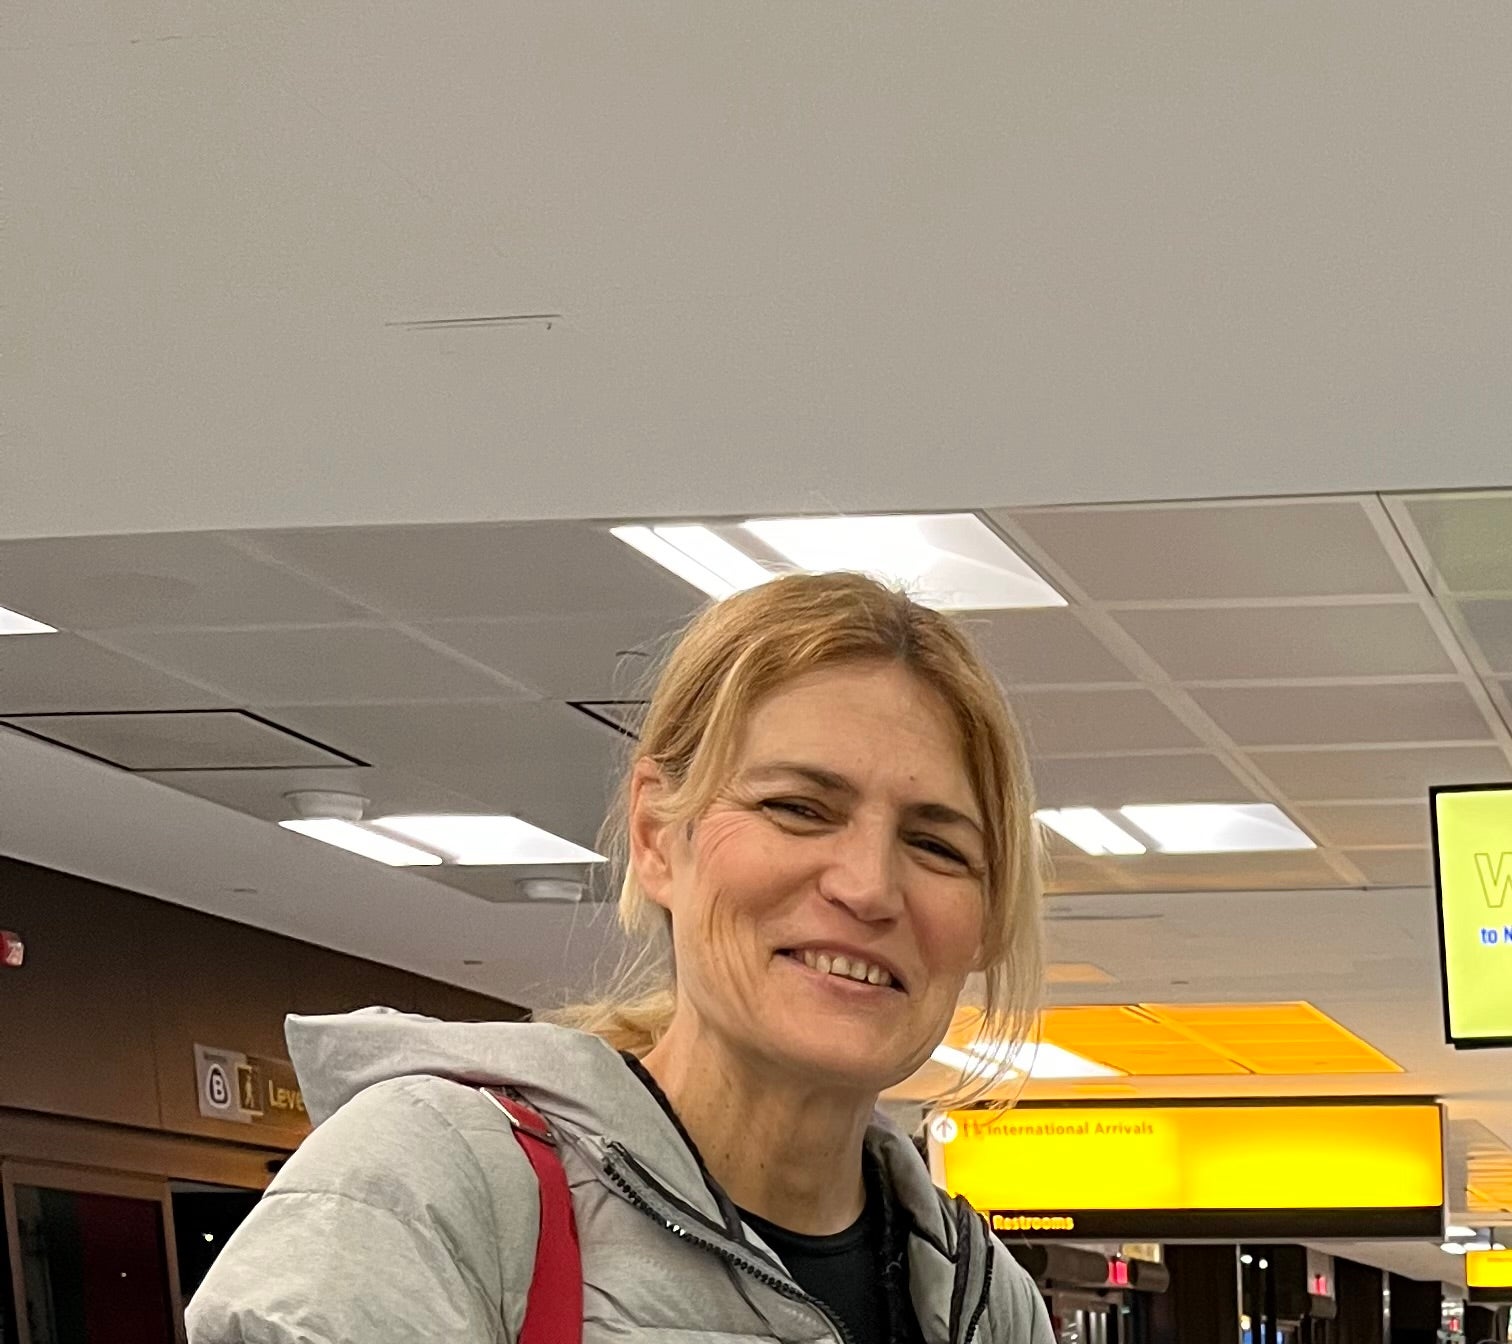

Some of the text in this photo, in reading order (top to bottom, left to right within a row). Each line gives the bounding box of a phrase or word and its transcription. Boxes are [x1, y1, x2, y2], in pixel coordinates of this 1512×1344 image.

[1481, 927, 1498, 944] to
[987, 1122, 1154, 1137] International Arrivals
